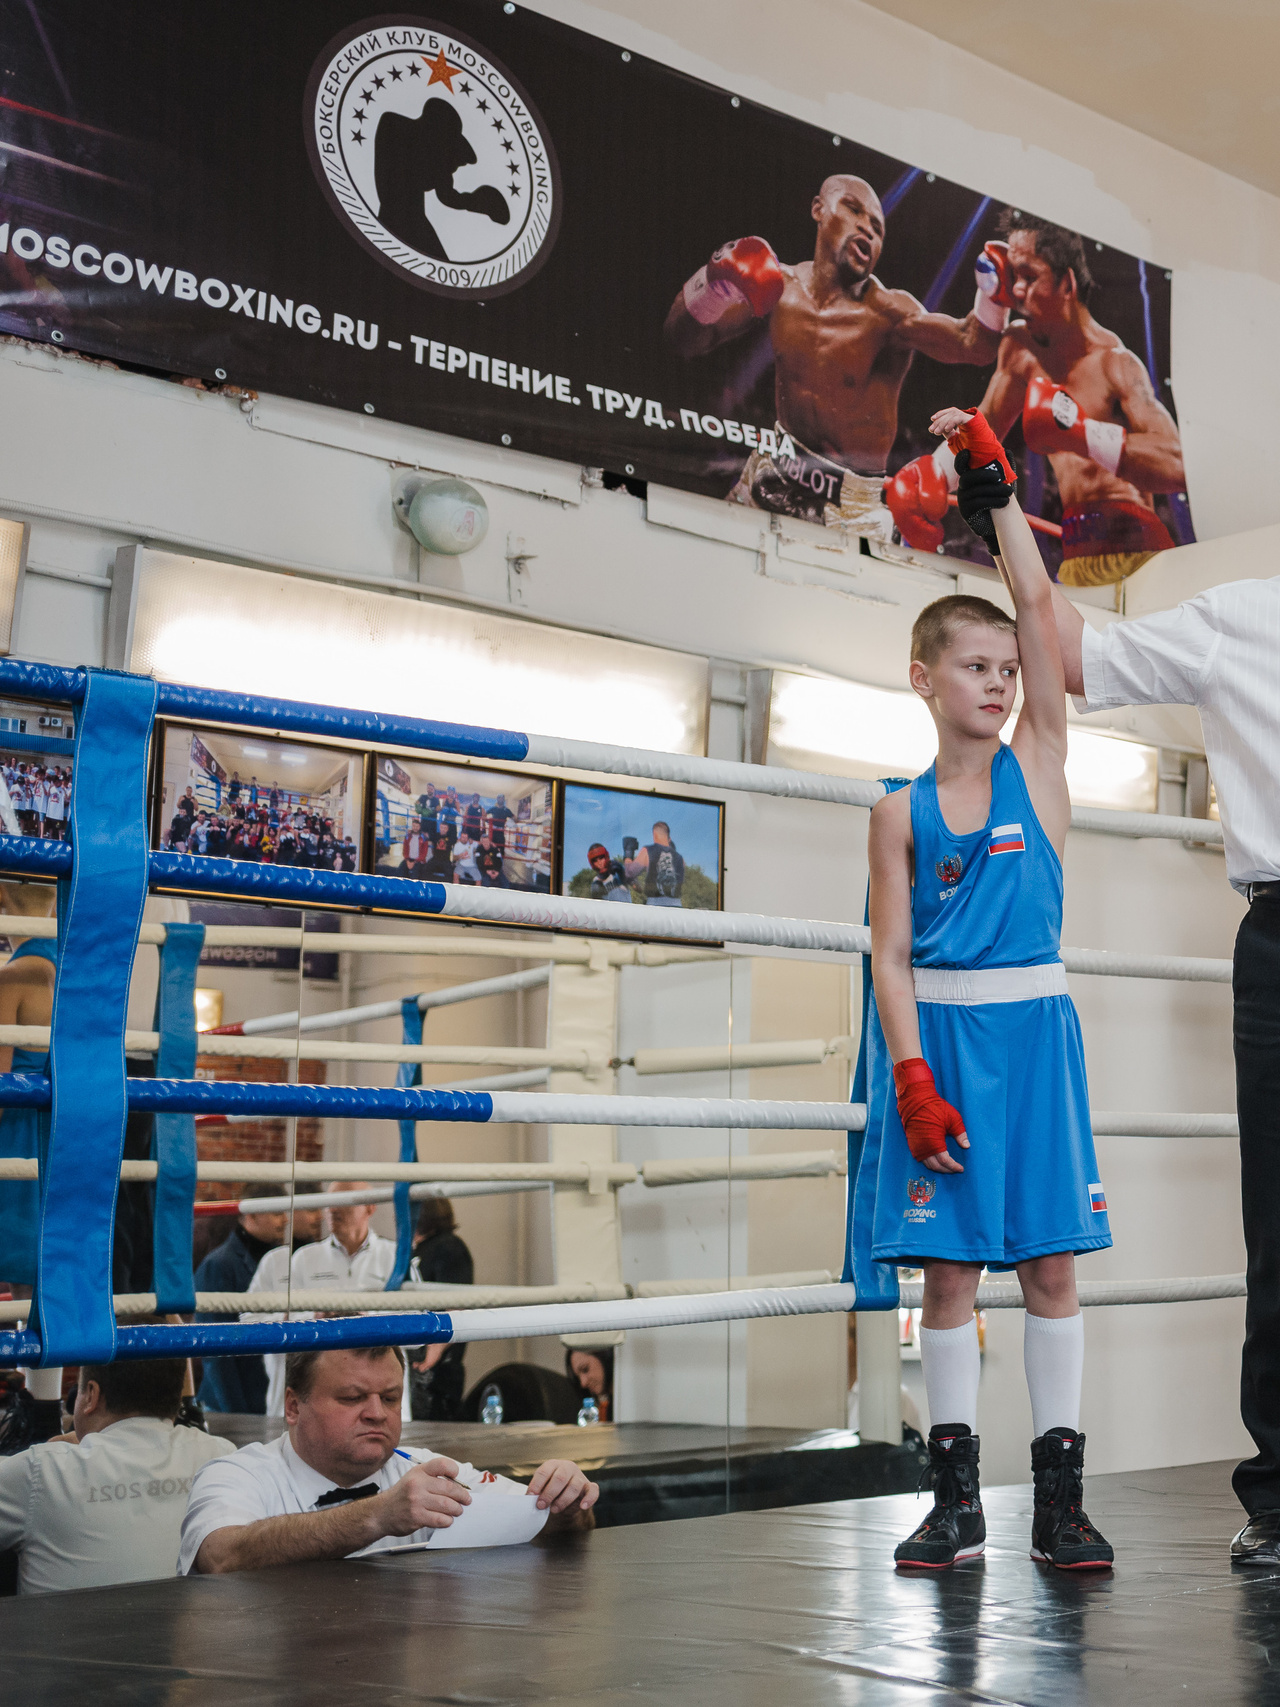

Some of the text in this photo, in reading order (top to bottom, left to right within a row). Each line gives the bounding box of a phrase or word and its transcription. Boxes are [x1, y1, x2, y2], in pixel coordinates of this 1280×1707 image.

[320, 31, 550, 204] БОКСЕРСКИЙ КЛУБ MOSCOWBOXING
[426, 262, 472, 287] 2009
[0, 222, 379, 351] OSCOWBOXING.RU
[410, 335, 581, 405] ТЕРПЕНИЕ.
[586, 383, 675, 430] ТРУД.
[680, 408, 796, 460] ПОБЕДА
[903, 1208, 937, 1218] BOXING
